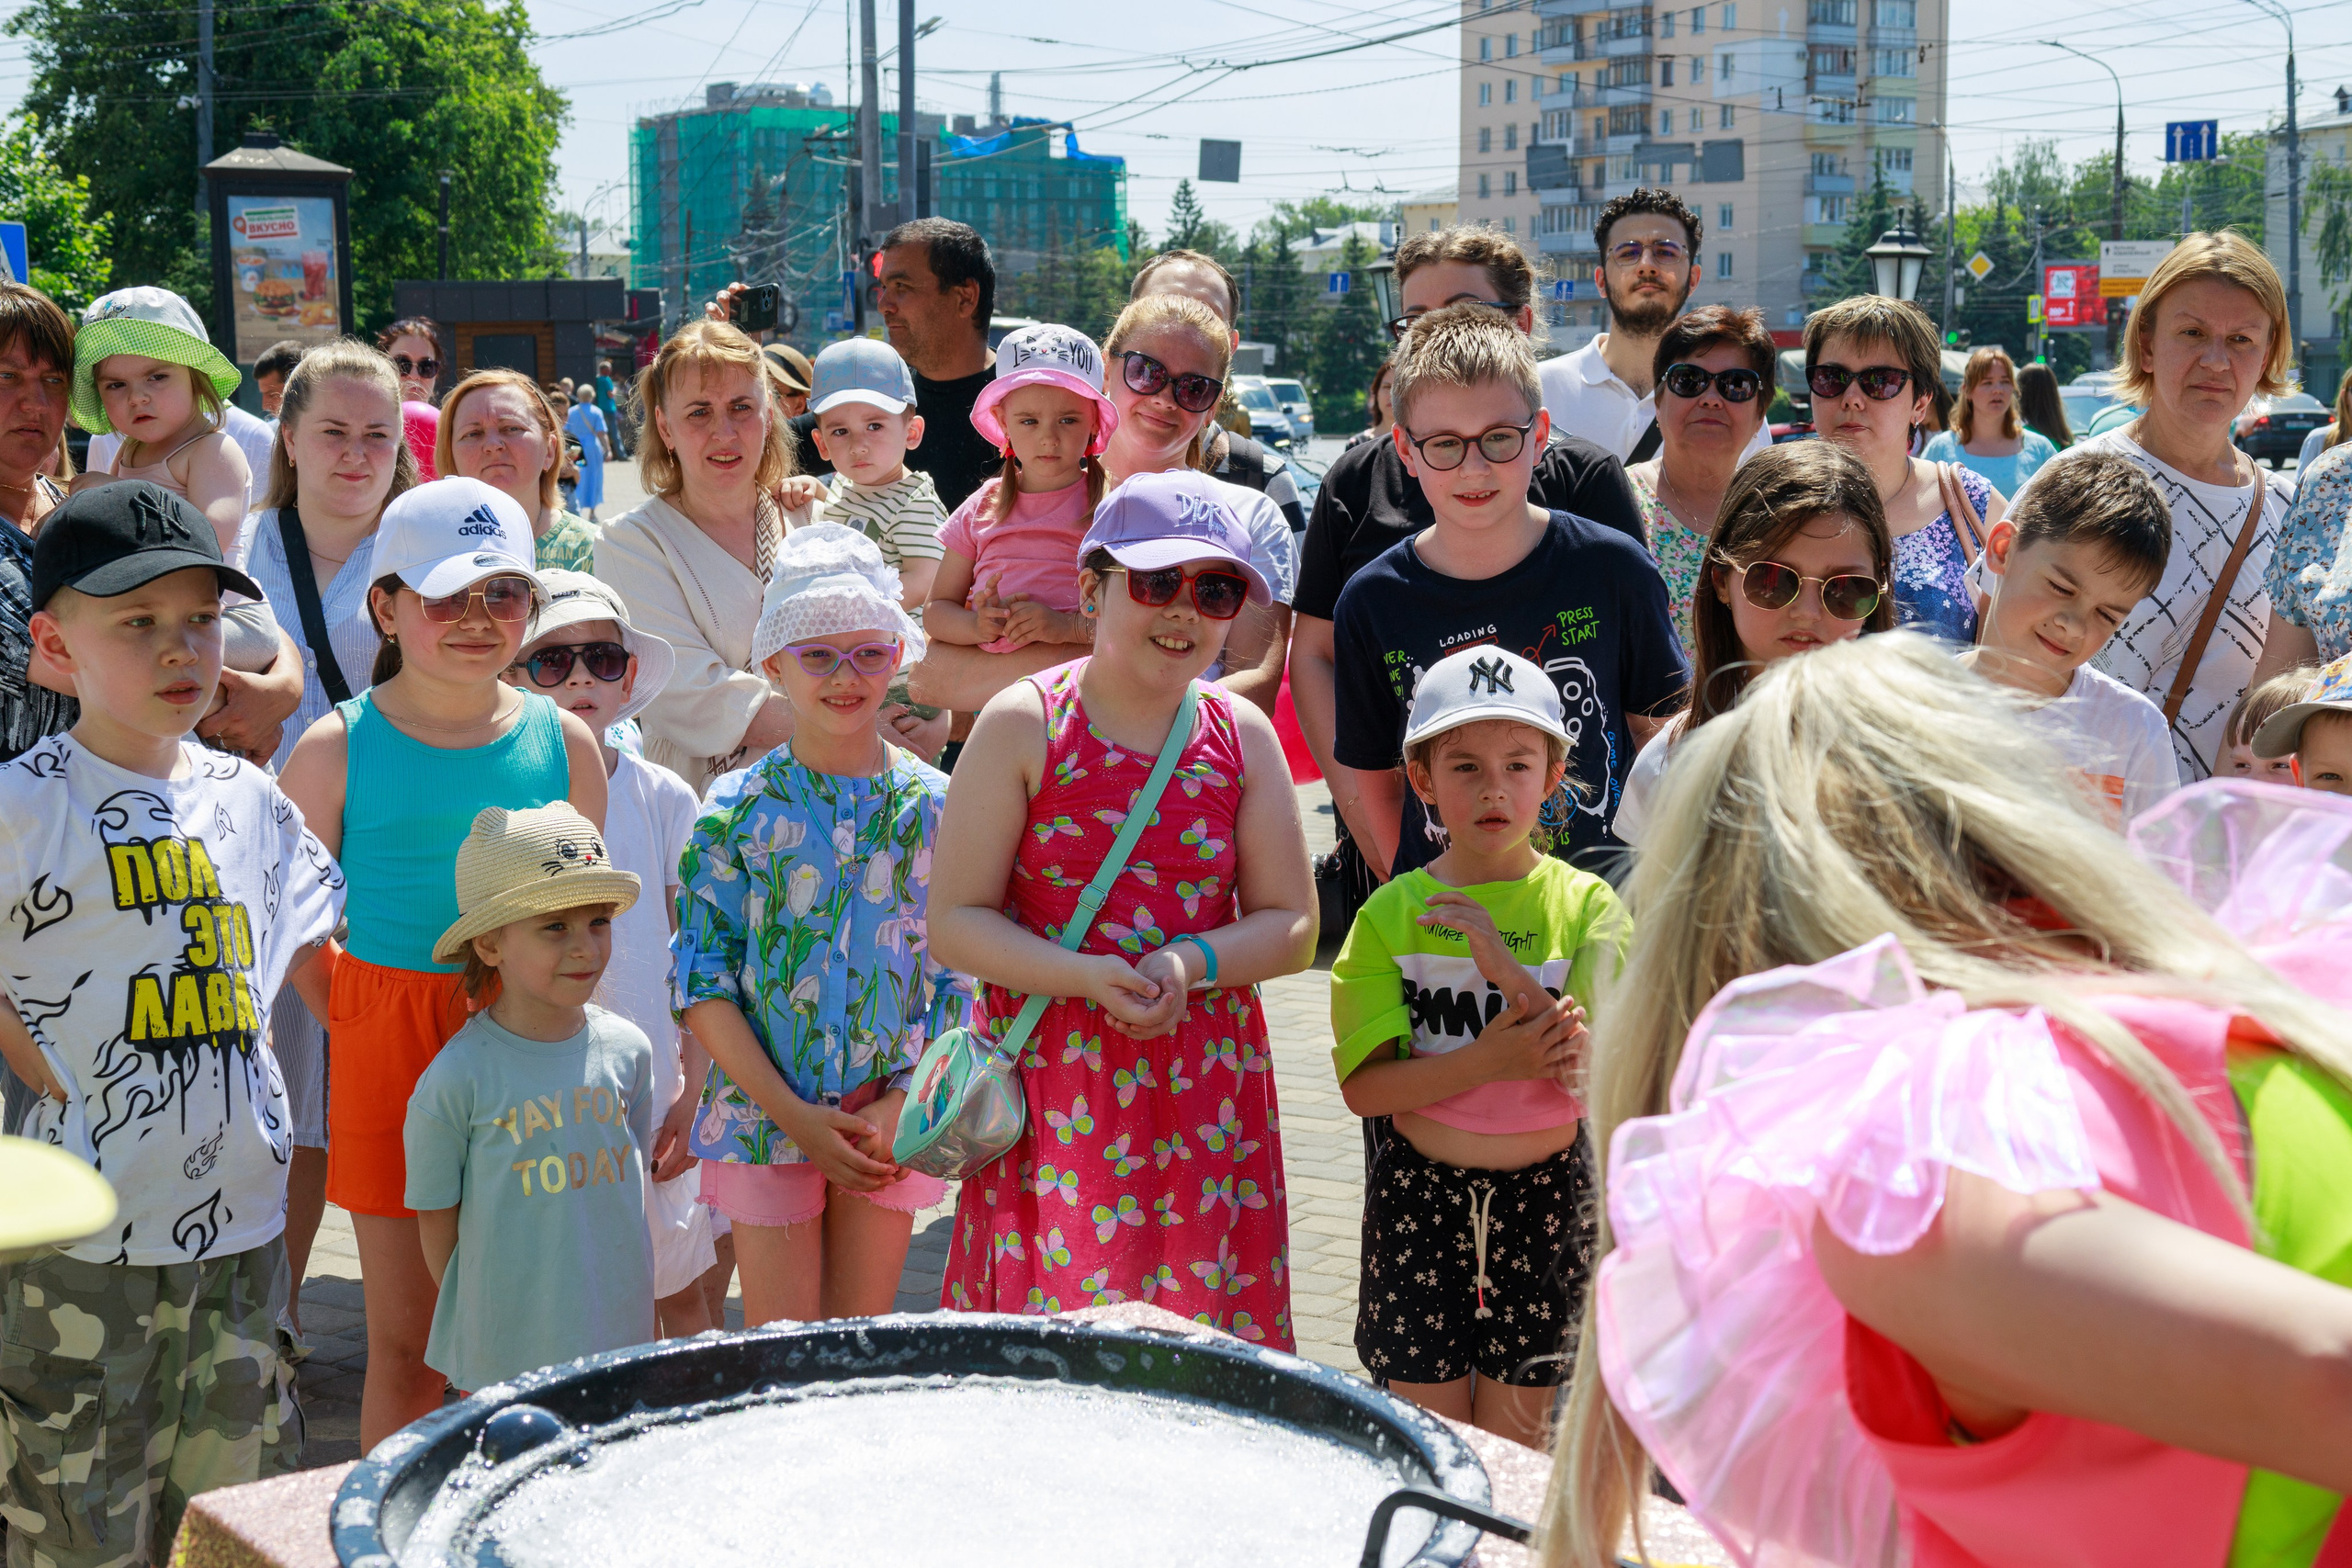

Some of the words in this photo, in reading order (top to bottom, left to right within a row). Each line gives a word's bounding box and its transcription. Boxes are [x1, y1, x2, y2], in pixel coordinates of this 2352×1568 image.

[249, 220, 295, 233] ВКУСНО
[1069, 341, 1092, 375] YOU
[458, 523, 507, 540] adidas
[1555, 605, 1594, 628] PRESS
[1439, 624, 1498, 648] LOADING
[1561, 620, 1600, 646] START
[1383, 649, 1408, 664] VER
[108, 837, 222, 908] ПОЛ
[184, 904, 253, 967] ЭТО
[130, 971, 260, 1041] ЛАВА
[492, 1089, 564, 1145] YAY
[511, 1144, 632, 1197] TODAY
